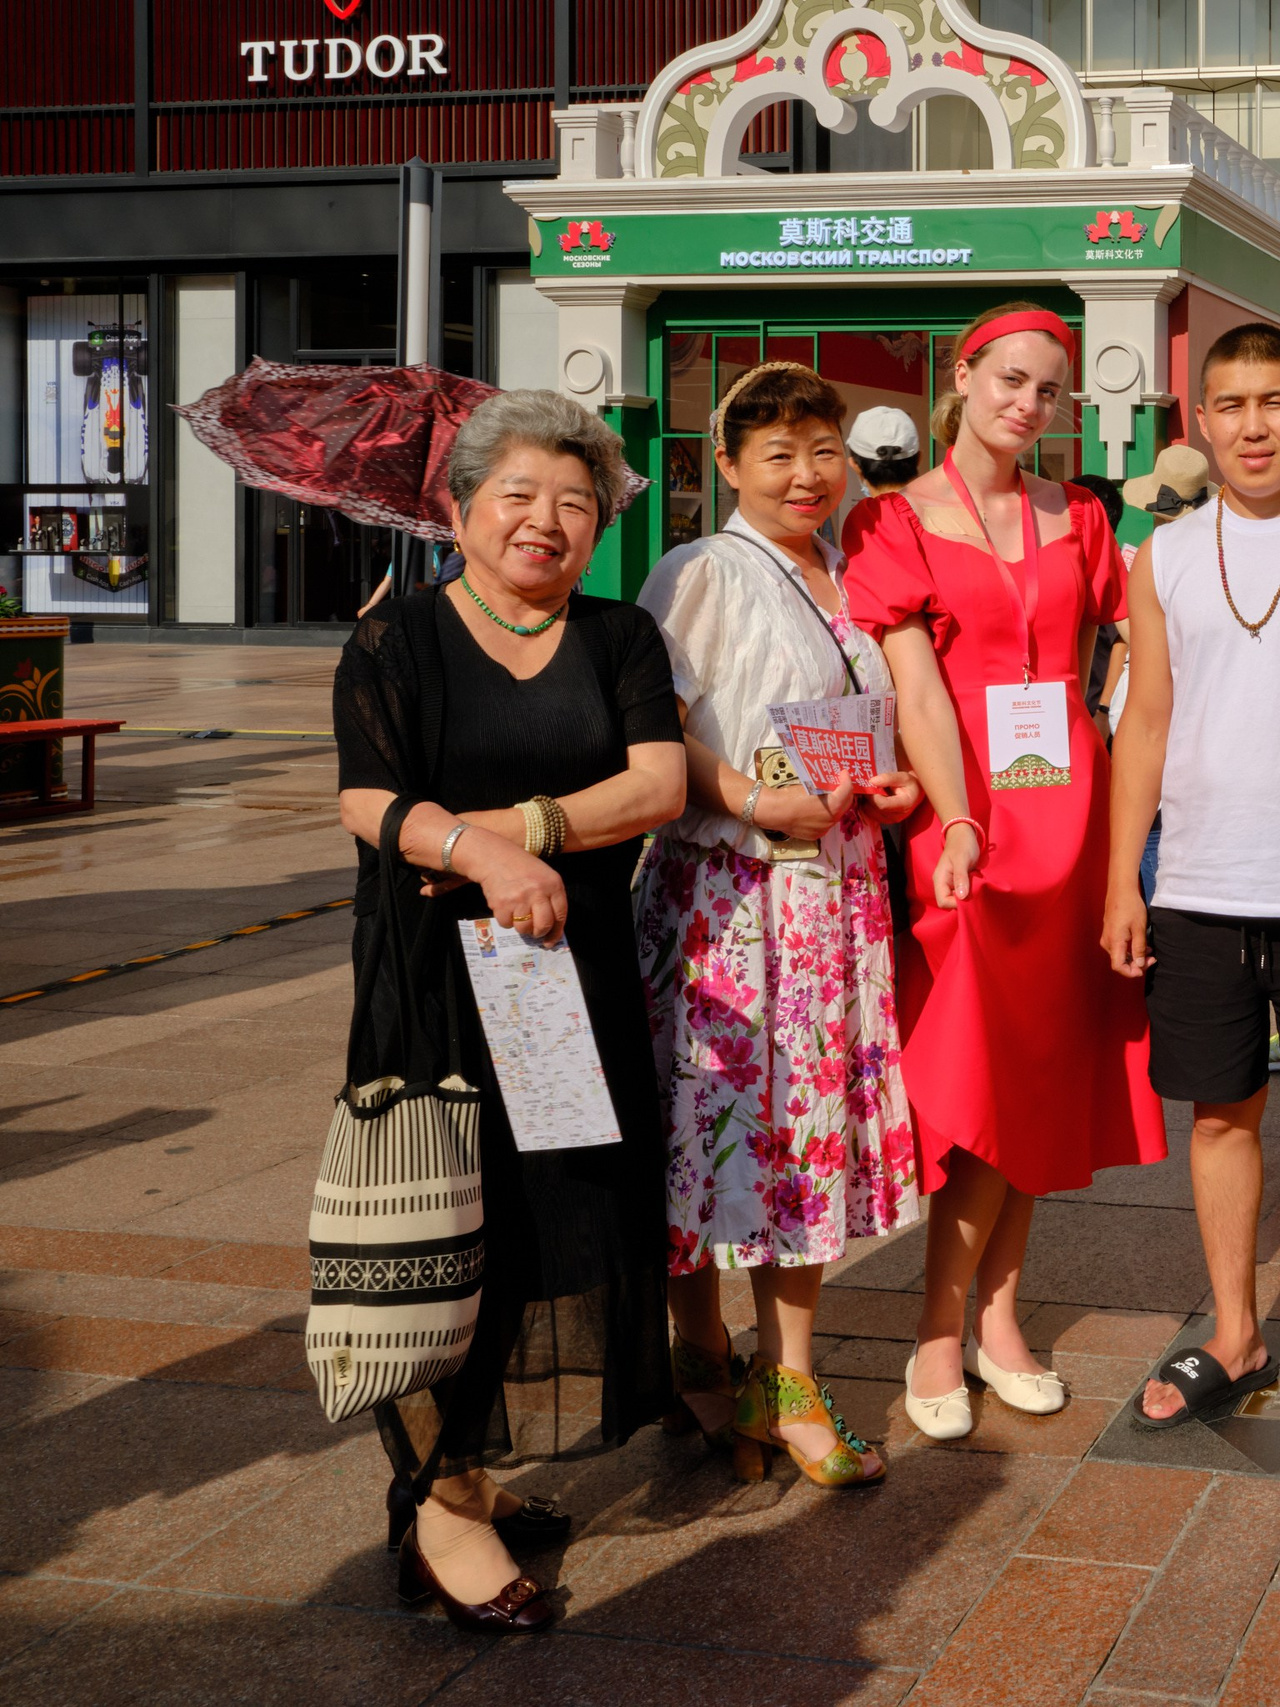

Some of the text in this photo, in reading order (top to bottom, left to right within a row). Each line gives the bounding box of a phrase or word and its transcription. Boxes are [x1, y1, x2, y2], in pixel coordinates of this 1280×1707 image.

[240, 33, 448, 82] TUDOR
[779, 216, 915, 248] 莫斯科交通
[563, 254, 611, 262] МОСКОВСКИЕ
[720, 248, 973, 269] МОСКОВСКИЙ ТРАНСПОРТ
[1085, 249, 1144, 260] 莫斯科文化节
[1014, 723, 1040, 731] ПРОМО
[1014, 731, 1041, 739] 促销人员
[793, 728, 872, 761] 莫斯科庄园
[1171, 1361, 1199, 1380] JOSS
